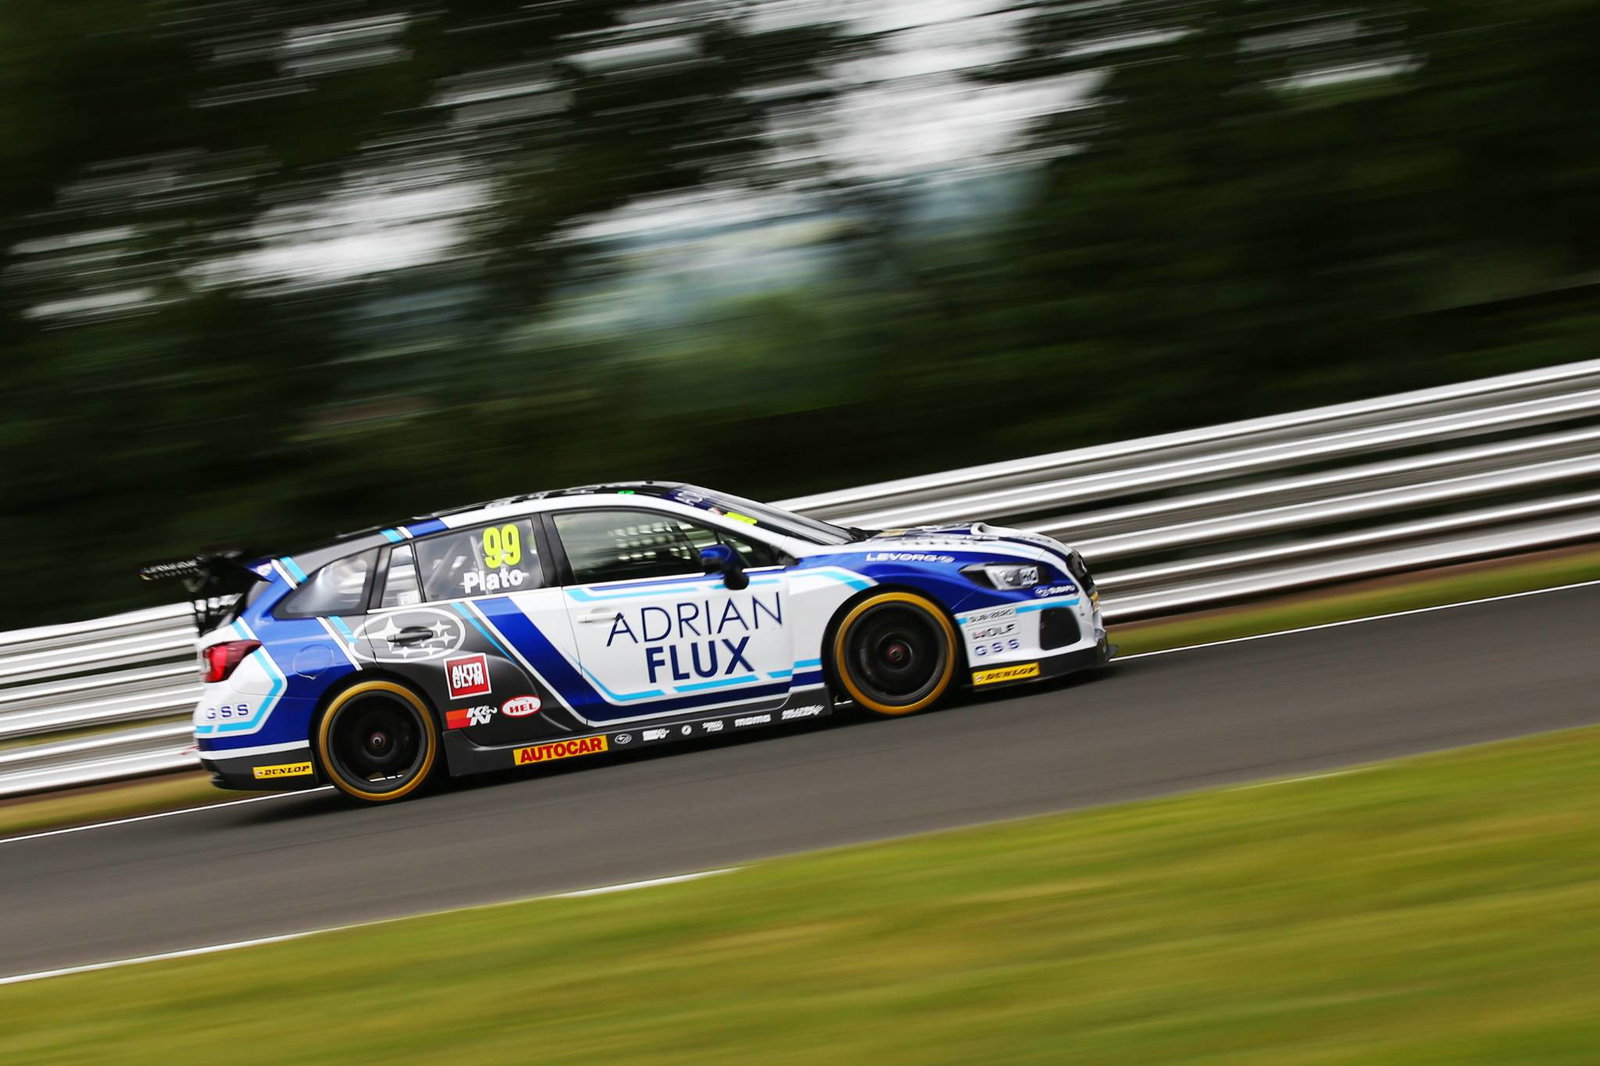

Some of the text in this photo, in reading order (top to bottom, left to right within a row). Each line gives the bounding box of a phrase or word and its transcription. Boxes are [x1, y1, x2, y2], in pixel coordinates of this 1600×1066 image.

[483, 524, 521, 569] 99
[463, 567, 523, 594] Plato
[606, 591, 783, 648] ADRIAN
[452, 661, 482, 678] AUTO
[645, 635, 756, 684] FLUX
[453, 672, 485, 689] GLYM
[985, 666, 1037, 680] DUNLOP
[466, 705, 498, 727] K&N
[509, 702, 536, 714] HEL
[520, 737, 602, 764] AUTOCAR
[264, 765, 310, 776] DUNLOP
